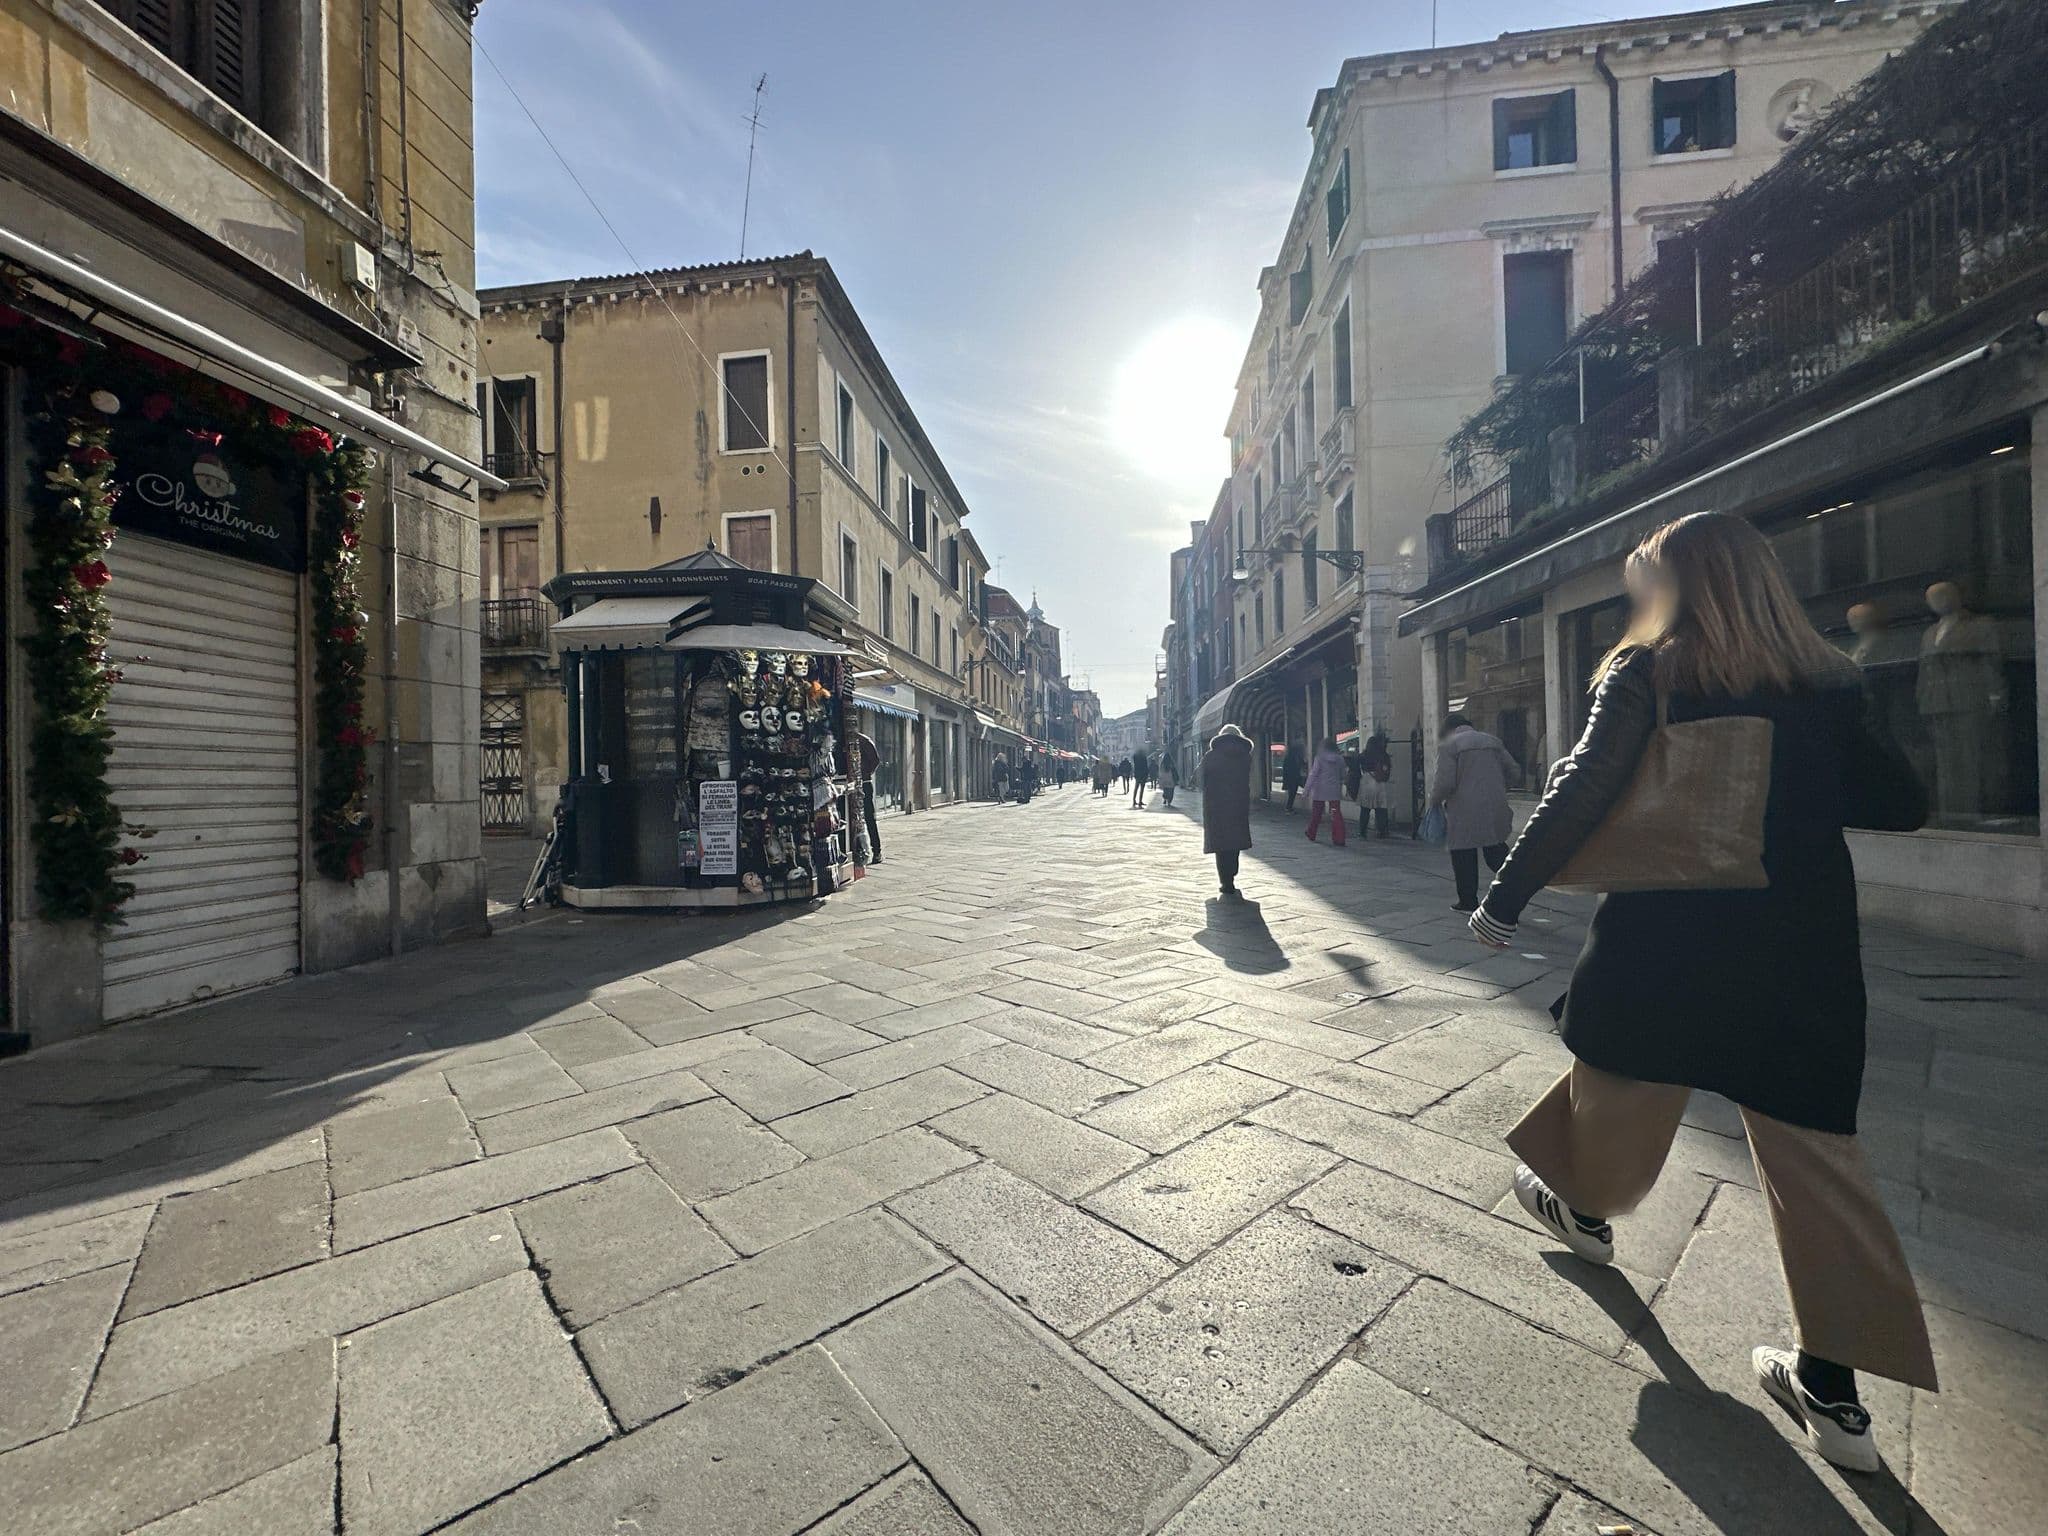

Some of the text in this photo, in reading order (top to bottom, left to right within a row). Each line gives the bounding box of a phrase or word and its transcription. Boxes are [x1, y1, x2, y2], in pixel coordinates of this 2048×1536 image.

[136, 473, 280, 539] Christmas
[179, 516, 199, 529] THE
[571, 578, 626, 586] ABBONAMENTI
[672, 575, 729, 583] ABONNEMENTS
[747, 577, 798, 589] BOAT PASSES
